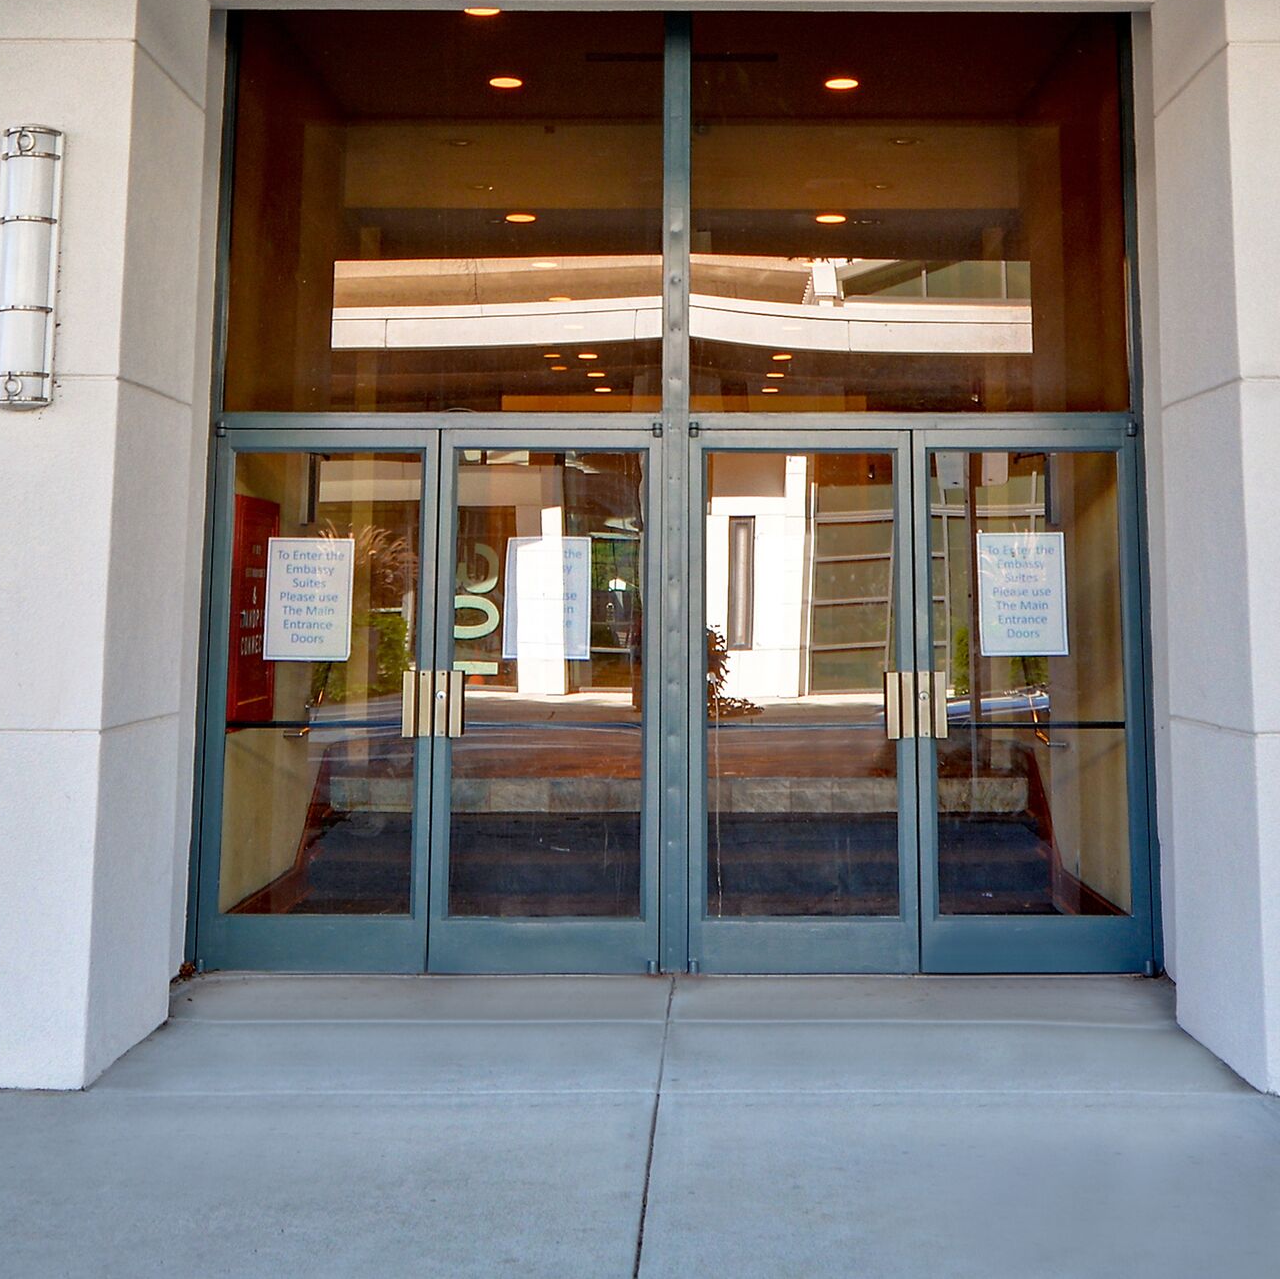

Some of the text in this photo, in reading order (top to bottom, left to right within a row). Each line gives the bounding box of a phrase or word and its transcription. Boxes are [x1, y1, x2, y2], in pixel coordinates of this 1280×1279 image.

[278, 549, 345, 560] To Enter the
[564, 548, 583, 559] the
[987, 545, 1000, 555] To
[1036, 545, 1055, 555] the
[286, 563, 335, 576] Embassy
[998, 559, 1045, 570] Embassy
[292, 577, 327, 588] Suites
[1005, 574, 1039, 583] Suites
[280, 591, 338, 603] Please use
[993, 587, 1052, 597] Please use
[282, 605, 335, 616] The Main
[996, 601, 1049, 610] The Main
[283, 619, 333, 630] Entrance
[998, 615, 1048, 625] Entrance
[291, 633, 324, 644] Doors
[1007, 628, 1040, 638] Doors
